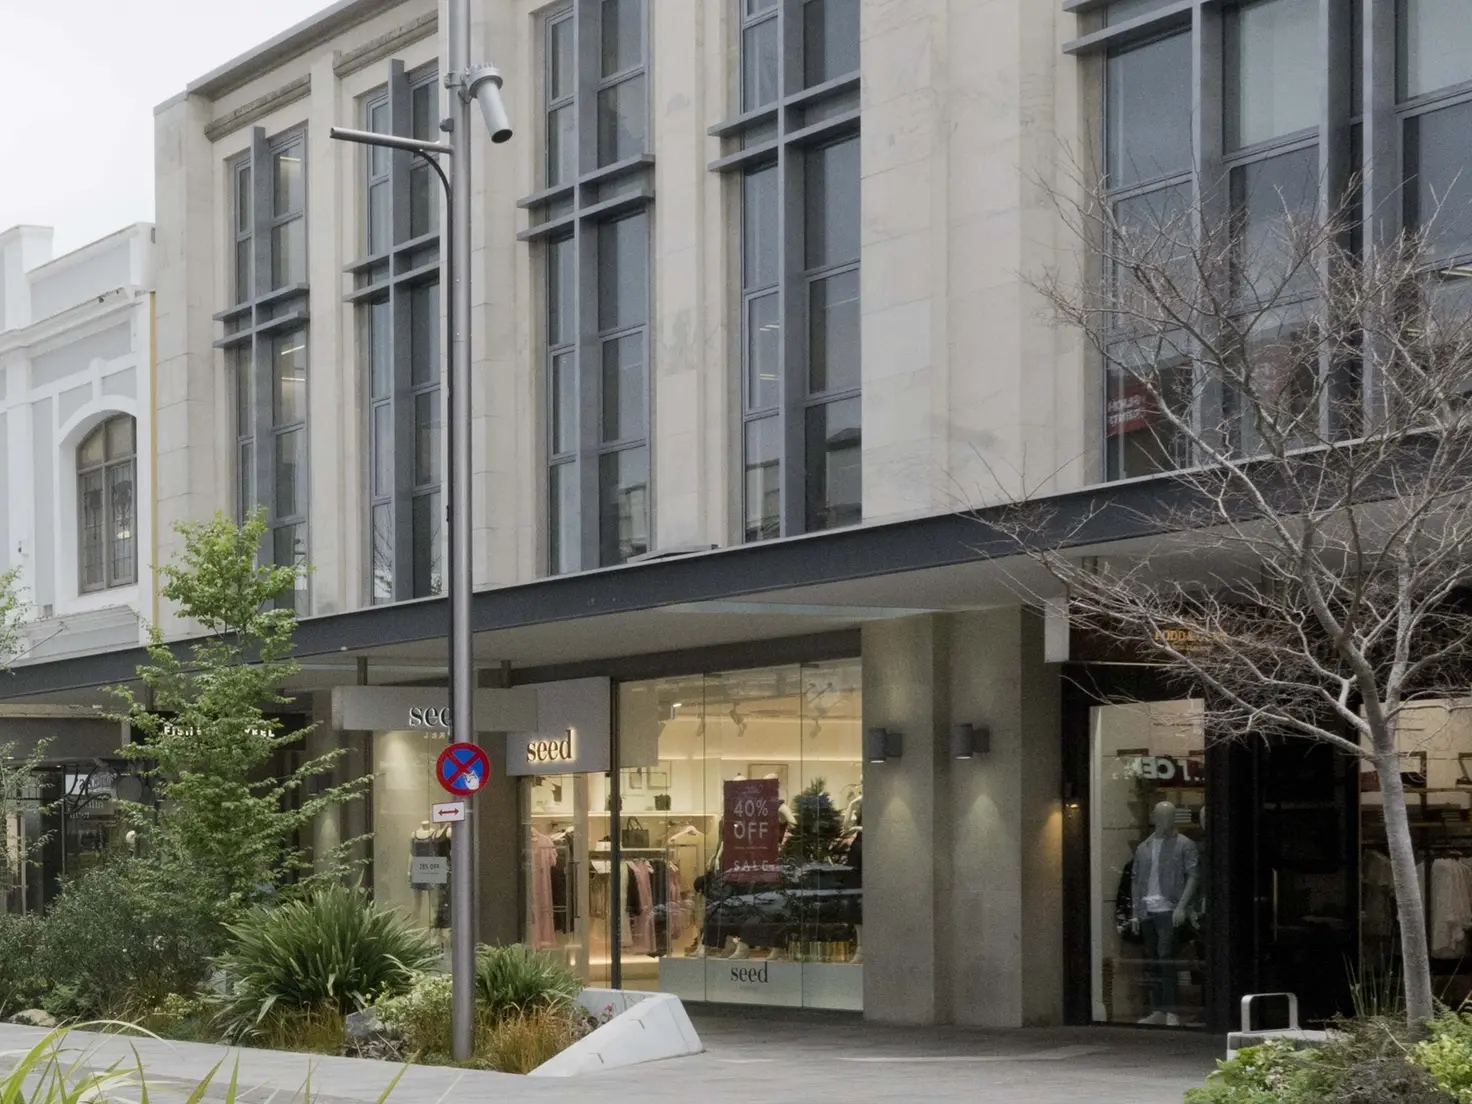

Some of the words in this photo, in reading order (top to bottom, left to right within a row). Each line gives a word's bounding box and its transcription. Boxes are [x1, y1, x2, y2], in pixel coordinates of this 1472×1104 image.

[409, 706, 449, 728] see
[526, 729, 575, 762] seed
[733, 800, 768, 818] 40%
[733, 821, 769, 839] OFF
[733, 860, 769, 872] SALE
[730, 960, 768, 984] seed
